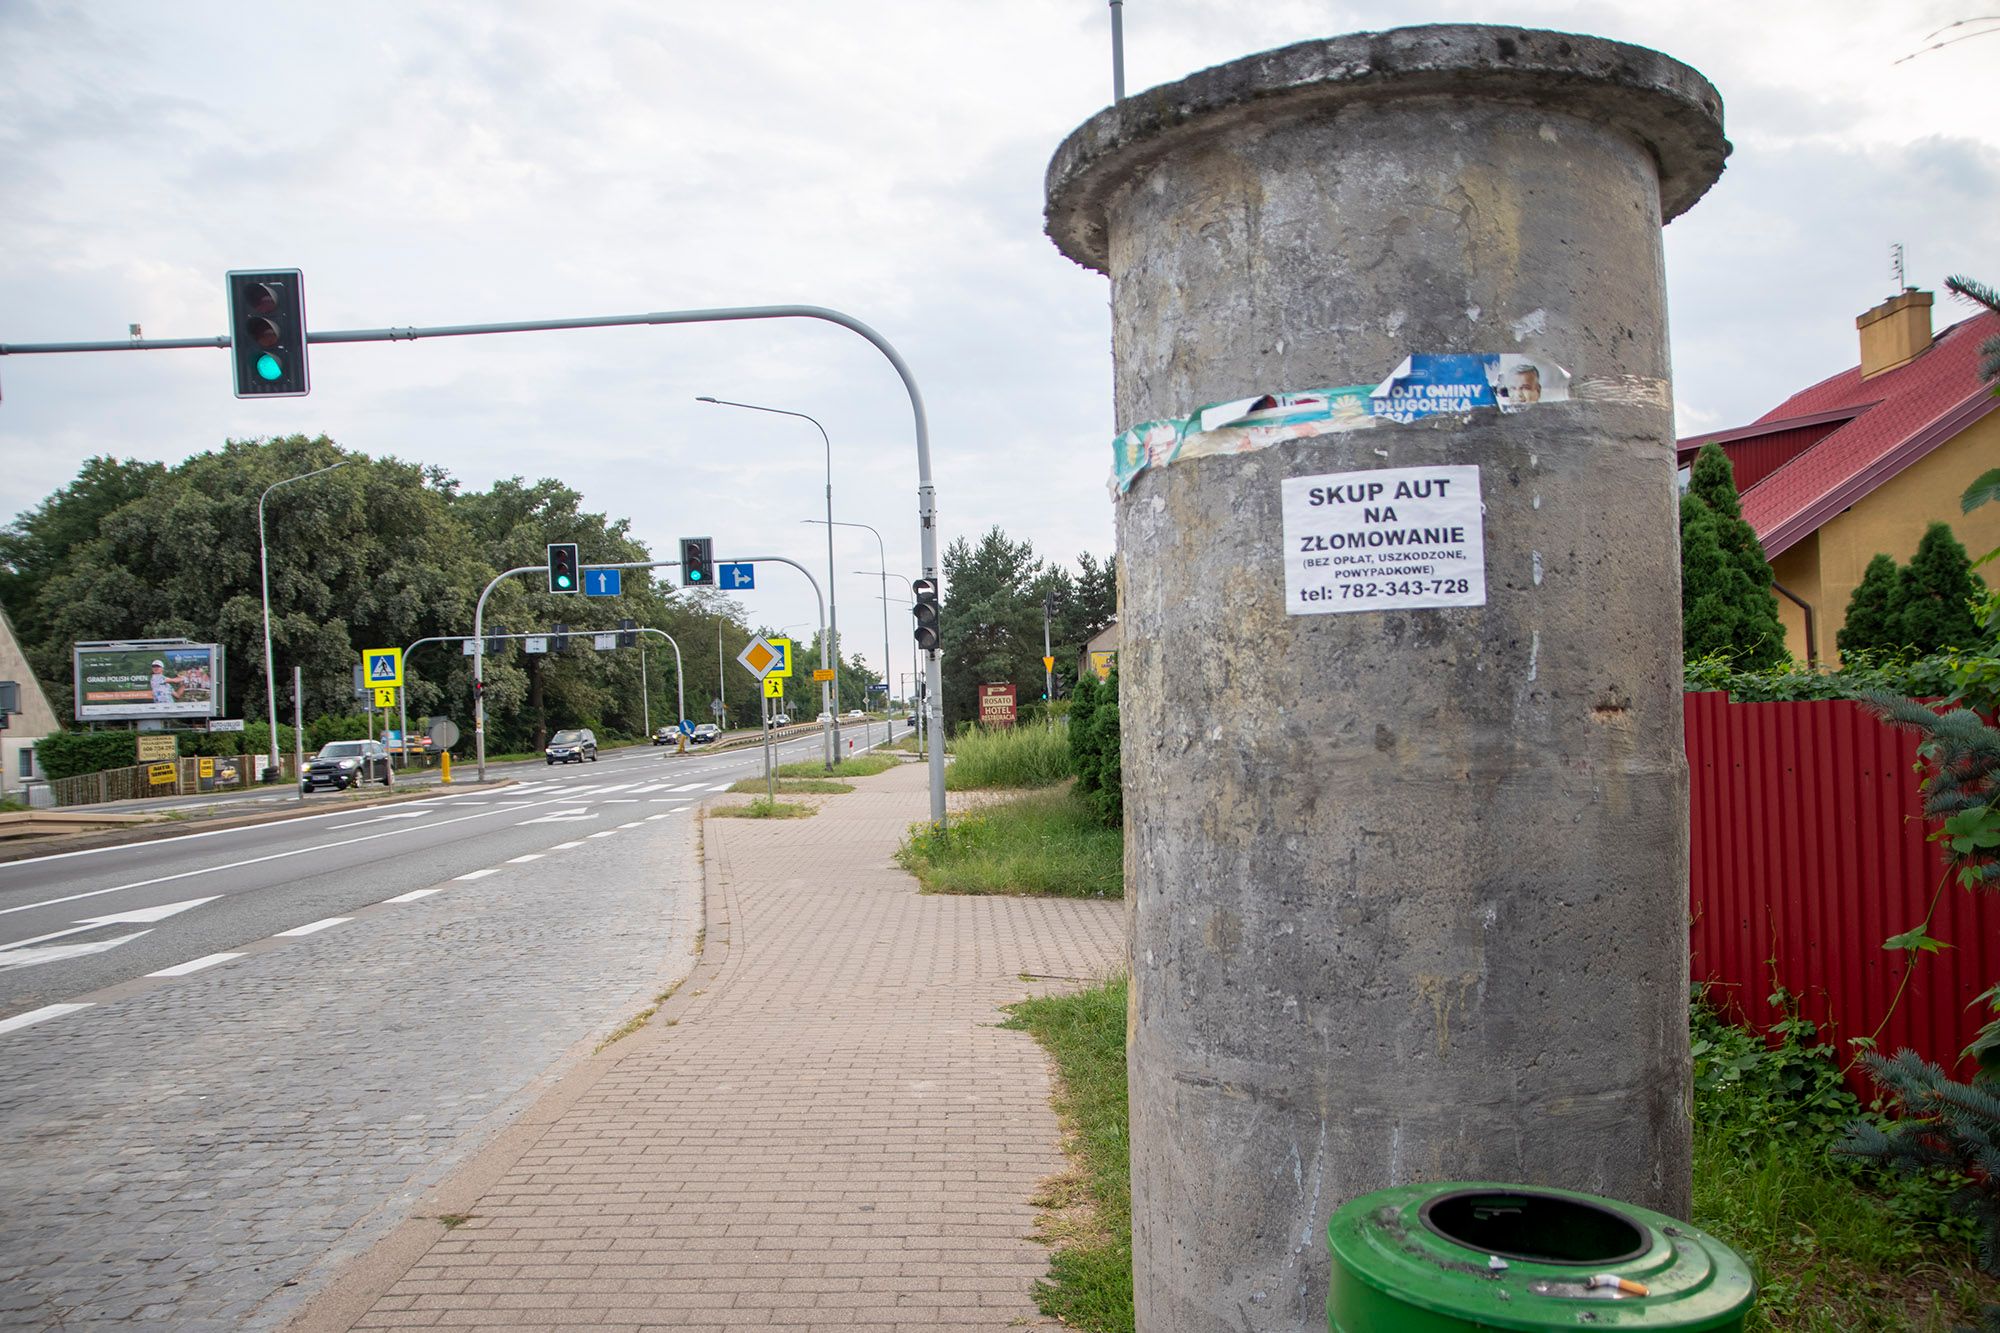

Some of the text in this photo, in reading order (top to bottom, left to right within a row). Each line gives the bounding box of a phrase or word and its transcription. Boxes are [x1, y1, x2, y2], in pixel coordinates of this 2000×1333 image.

[1426, 384, 1482, 398] GMINY
[1309, 479, 1451, 507] SKUP AUT
[1364, 506, 1398, 524] NA
[1300, 526, 1465, 553] ZŁOMOWANIE
[1303, 550, 1467, 570] (BEZ OPŁAT, USZKODZONE,
[1335, 565, 1434, 579] POWYPADKOWE)
[1300, 578, 1469, 602] tel: 782-343-728
[130, 674, 148, 682] OPEN
[984, 697, 1011, 705] ROSATO
[984, 706, 1011, 715] HOTEL
